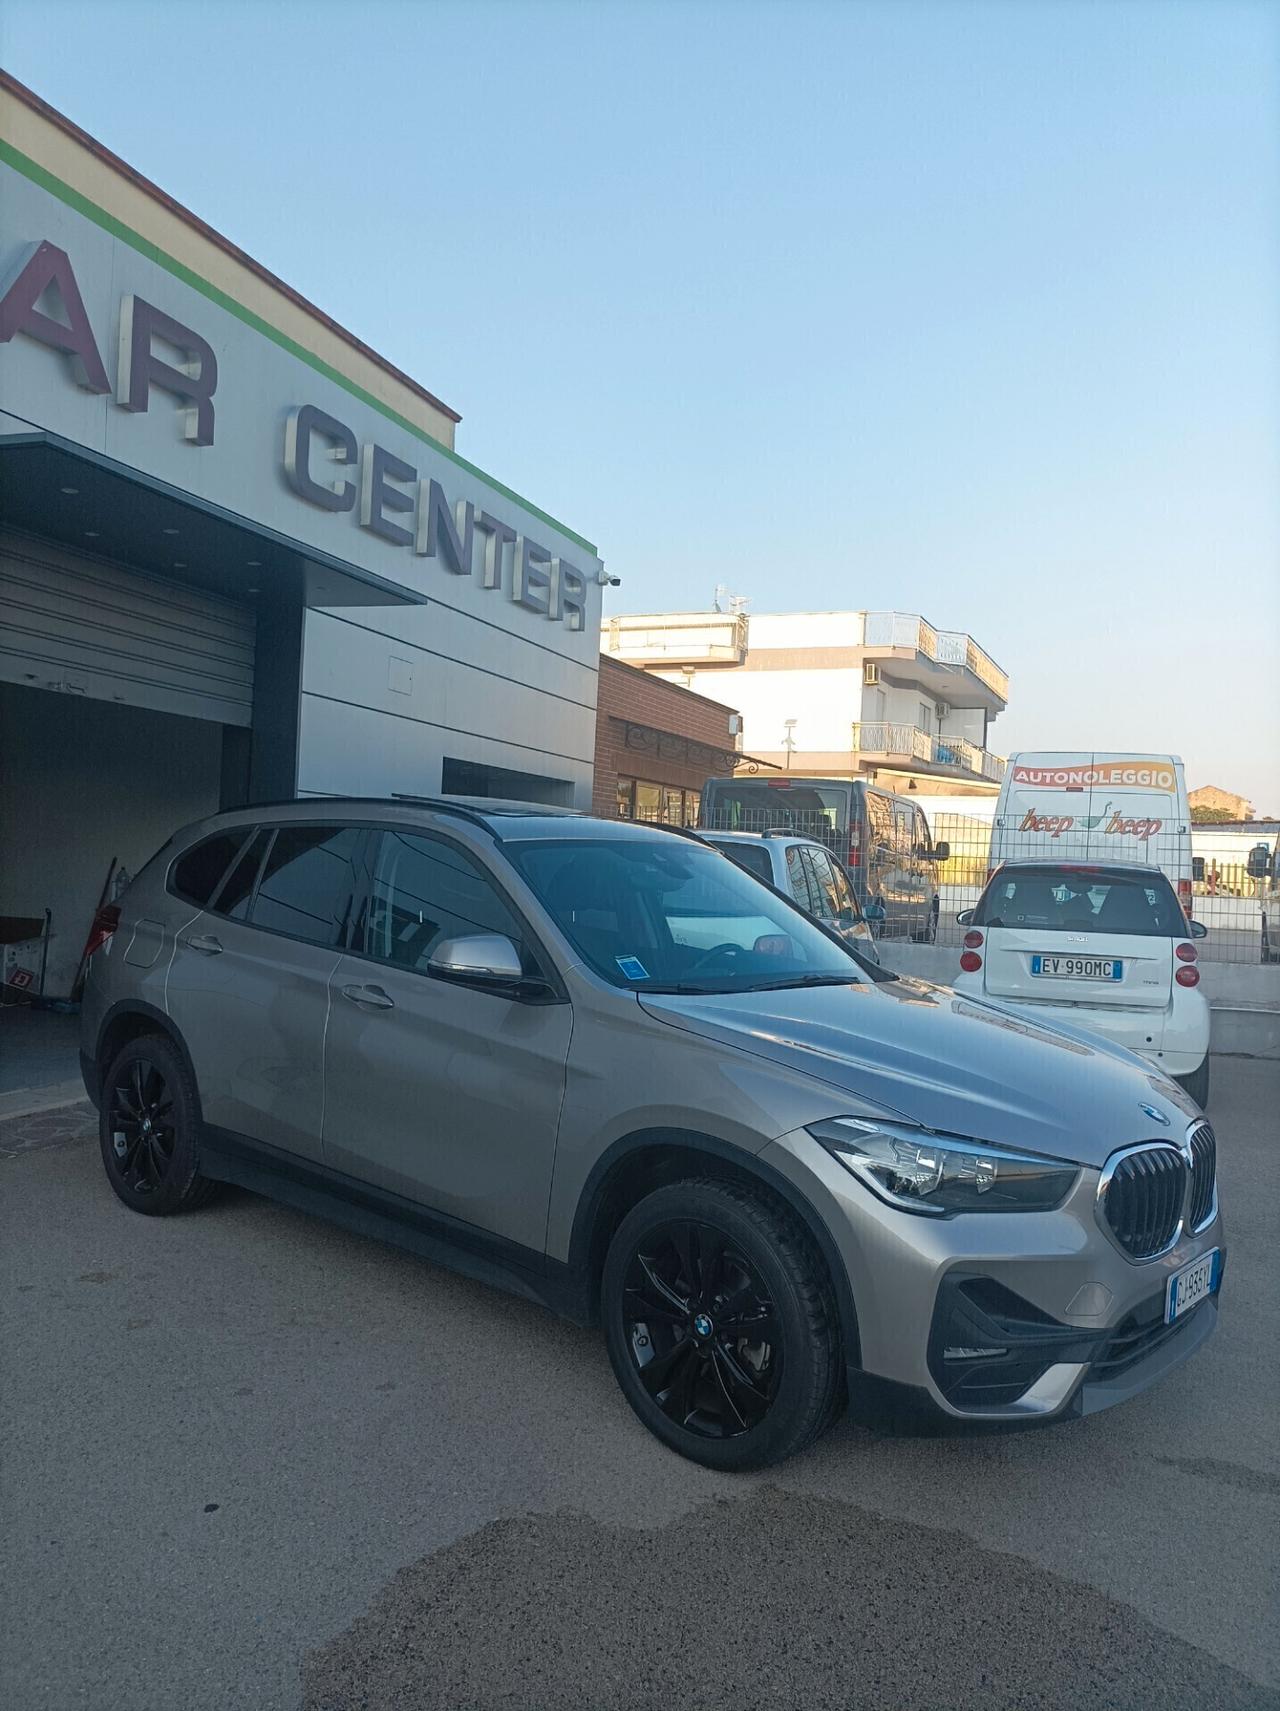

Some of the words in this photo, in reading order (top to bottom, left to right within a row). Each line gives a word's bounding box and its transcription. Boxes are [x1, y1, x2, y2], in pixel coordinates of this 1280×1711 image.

[286, 404, 586, 632] CENTER
[1015, 769, 1174, 788] AUTONOLEGGIO
[1018, 808, 1075, 838] beep
[1104, 810, 1163, 841] beep
